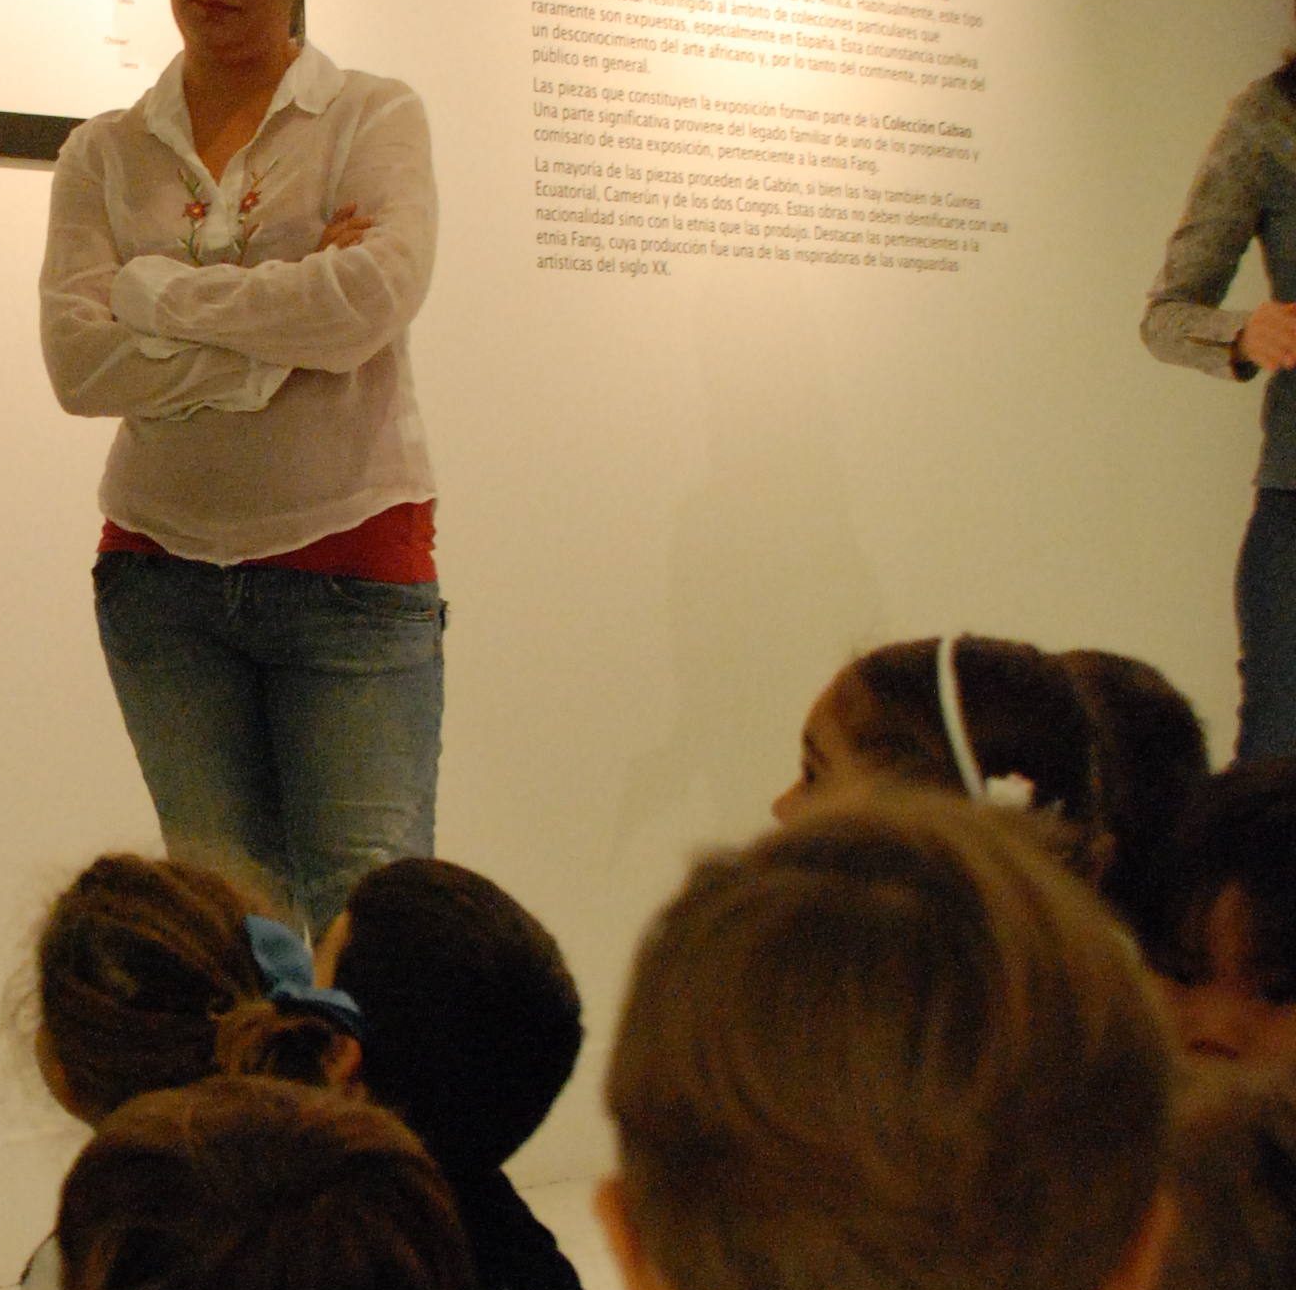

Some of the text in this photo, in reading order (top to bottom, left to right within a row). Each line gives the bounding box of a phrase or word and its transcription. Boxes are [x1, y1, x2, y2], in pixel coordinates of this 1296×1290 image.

[531, 0, 596, 20] raramente
[599, 9, 622, 22] son
[693, 21, 776, 43] especialmente
[716, 0, 727, 13] al
[730, 2, 771, 19] ámbito
[532, 24, 548, 38] un
[552, 23, 657, 51] desconocimiento
[660, 37, 679, 53] del
[682, 43, 705, 57] arte
[708, 43, 756, 63] africano
[532, 47, 651, 74] público en general.
[533, 76, 553, 94] Las
[558, 82, 598, 99] piezas
[601, 87, 624, 102] que
[627, 90, 698, 110] constituyen
[700, 93, 711, 110] la
[714, 99, 777, 116] exposición
[822, 111, 851, 125] parte
[533, 100, 558, 118] Una
[562, 107, 595, 122] parte
[598, 110, 670, 129] significativa
[674, 118, 724, 134] proviene
[727, 122, 745, 136] del
[749, 122, 787, 142] legado
[533, 128, 595, 145] comisario
[599, 133, 614, 147] de
[617, 136, 642, 150] esta
[717, 145, 795, 164] perteneciente
[534, 156, 549, 172] La
[553, 160, 603, 177] mayoría
[606, 162, 622, 179] de
[625, 163, 642, 180] las
[646, 169, 684, 184] piezas
[688, 172, 742, 188] proceden
[745, 175, 760, 190] de
[604, 185, 660, 204] Camerún
[663, 195, 670, 208] y
[672, 192, 688, 207] de
[691, 192, 708, 209] los
[711, 195, 733, 211] dos
[536, 207, 615, 225] nacionalidad
[618, 214, 644, 227] sino
[647, 216, 670, 228] con
[673, 214, 684, 230] la
[687, 218, 716, 232] etnia
[719, 221, 741, 236] que
[744, 220, 760, 236] las
[536, 231, 567, 246] etnia
[609, 237, 637, 253] cuya
[640, 237, 707, 254] producción
[710, 239, 729, 257] fue
[732, 246, 754, 258] una
[757, 246, 772, 259] de
[596, 256, 615, 272] del
[619, 258, 648, 278] siglo
